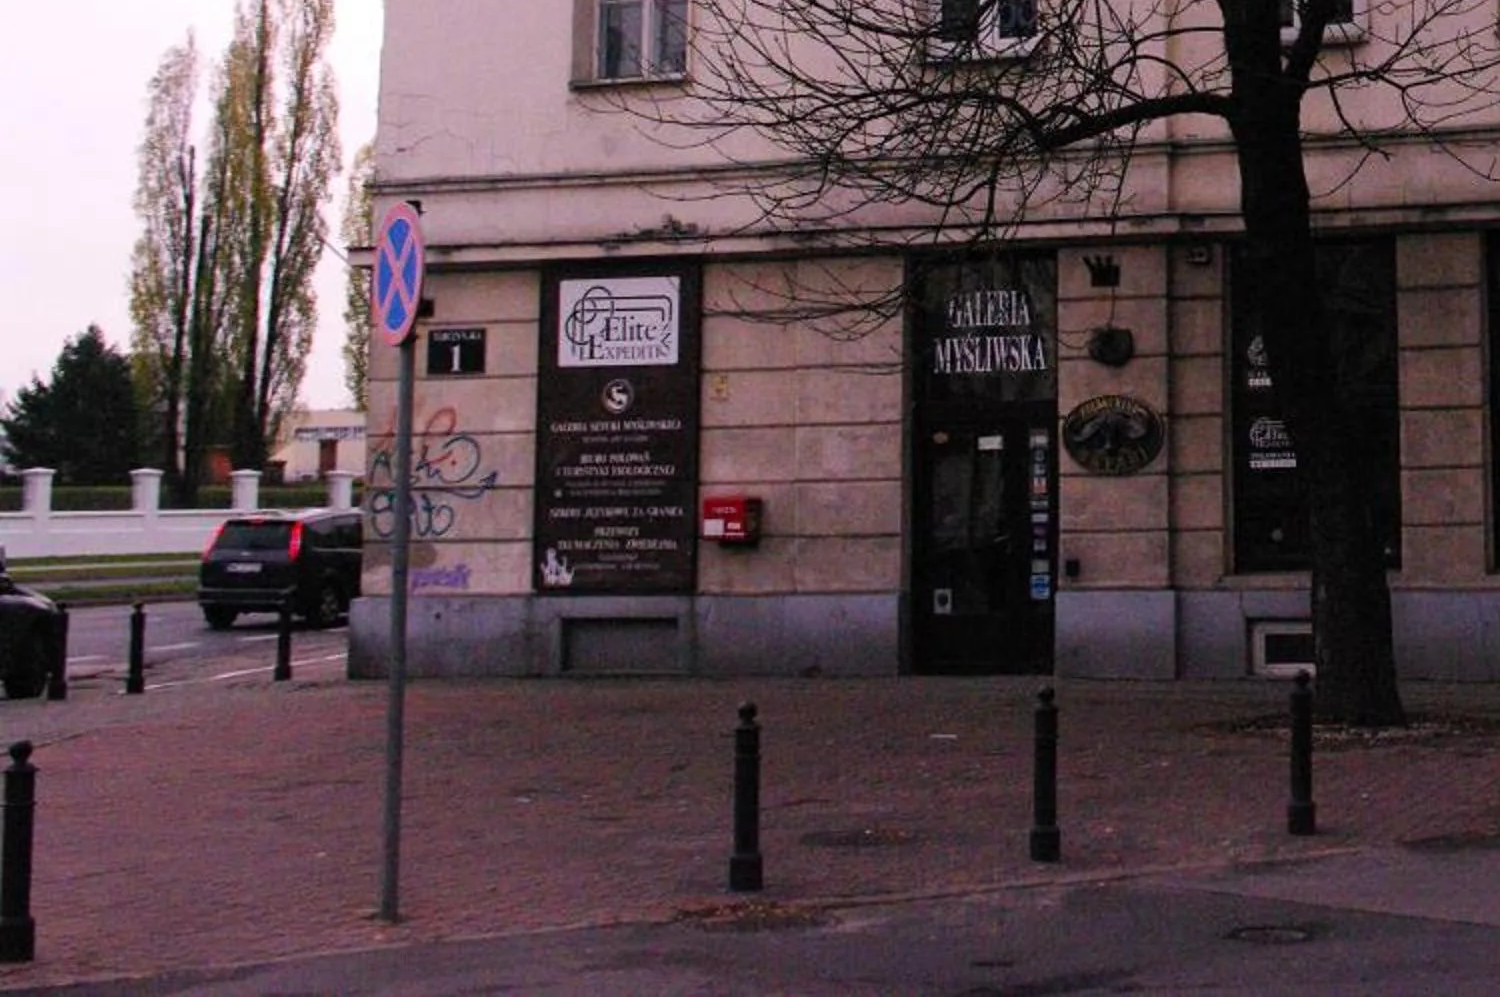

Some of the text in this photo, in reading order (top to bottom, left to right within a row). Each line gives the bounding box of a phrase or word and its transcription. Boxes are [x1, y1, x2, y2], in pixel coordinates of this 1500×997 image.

[944, 290, 1030, 328] GALERIA
[450, 344, 462, 372] 1
[933, 333, 1046, 373] MYŚLIWSKA
